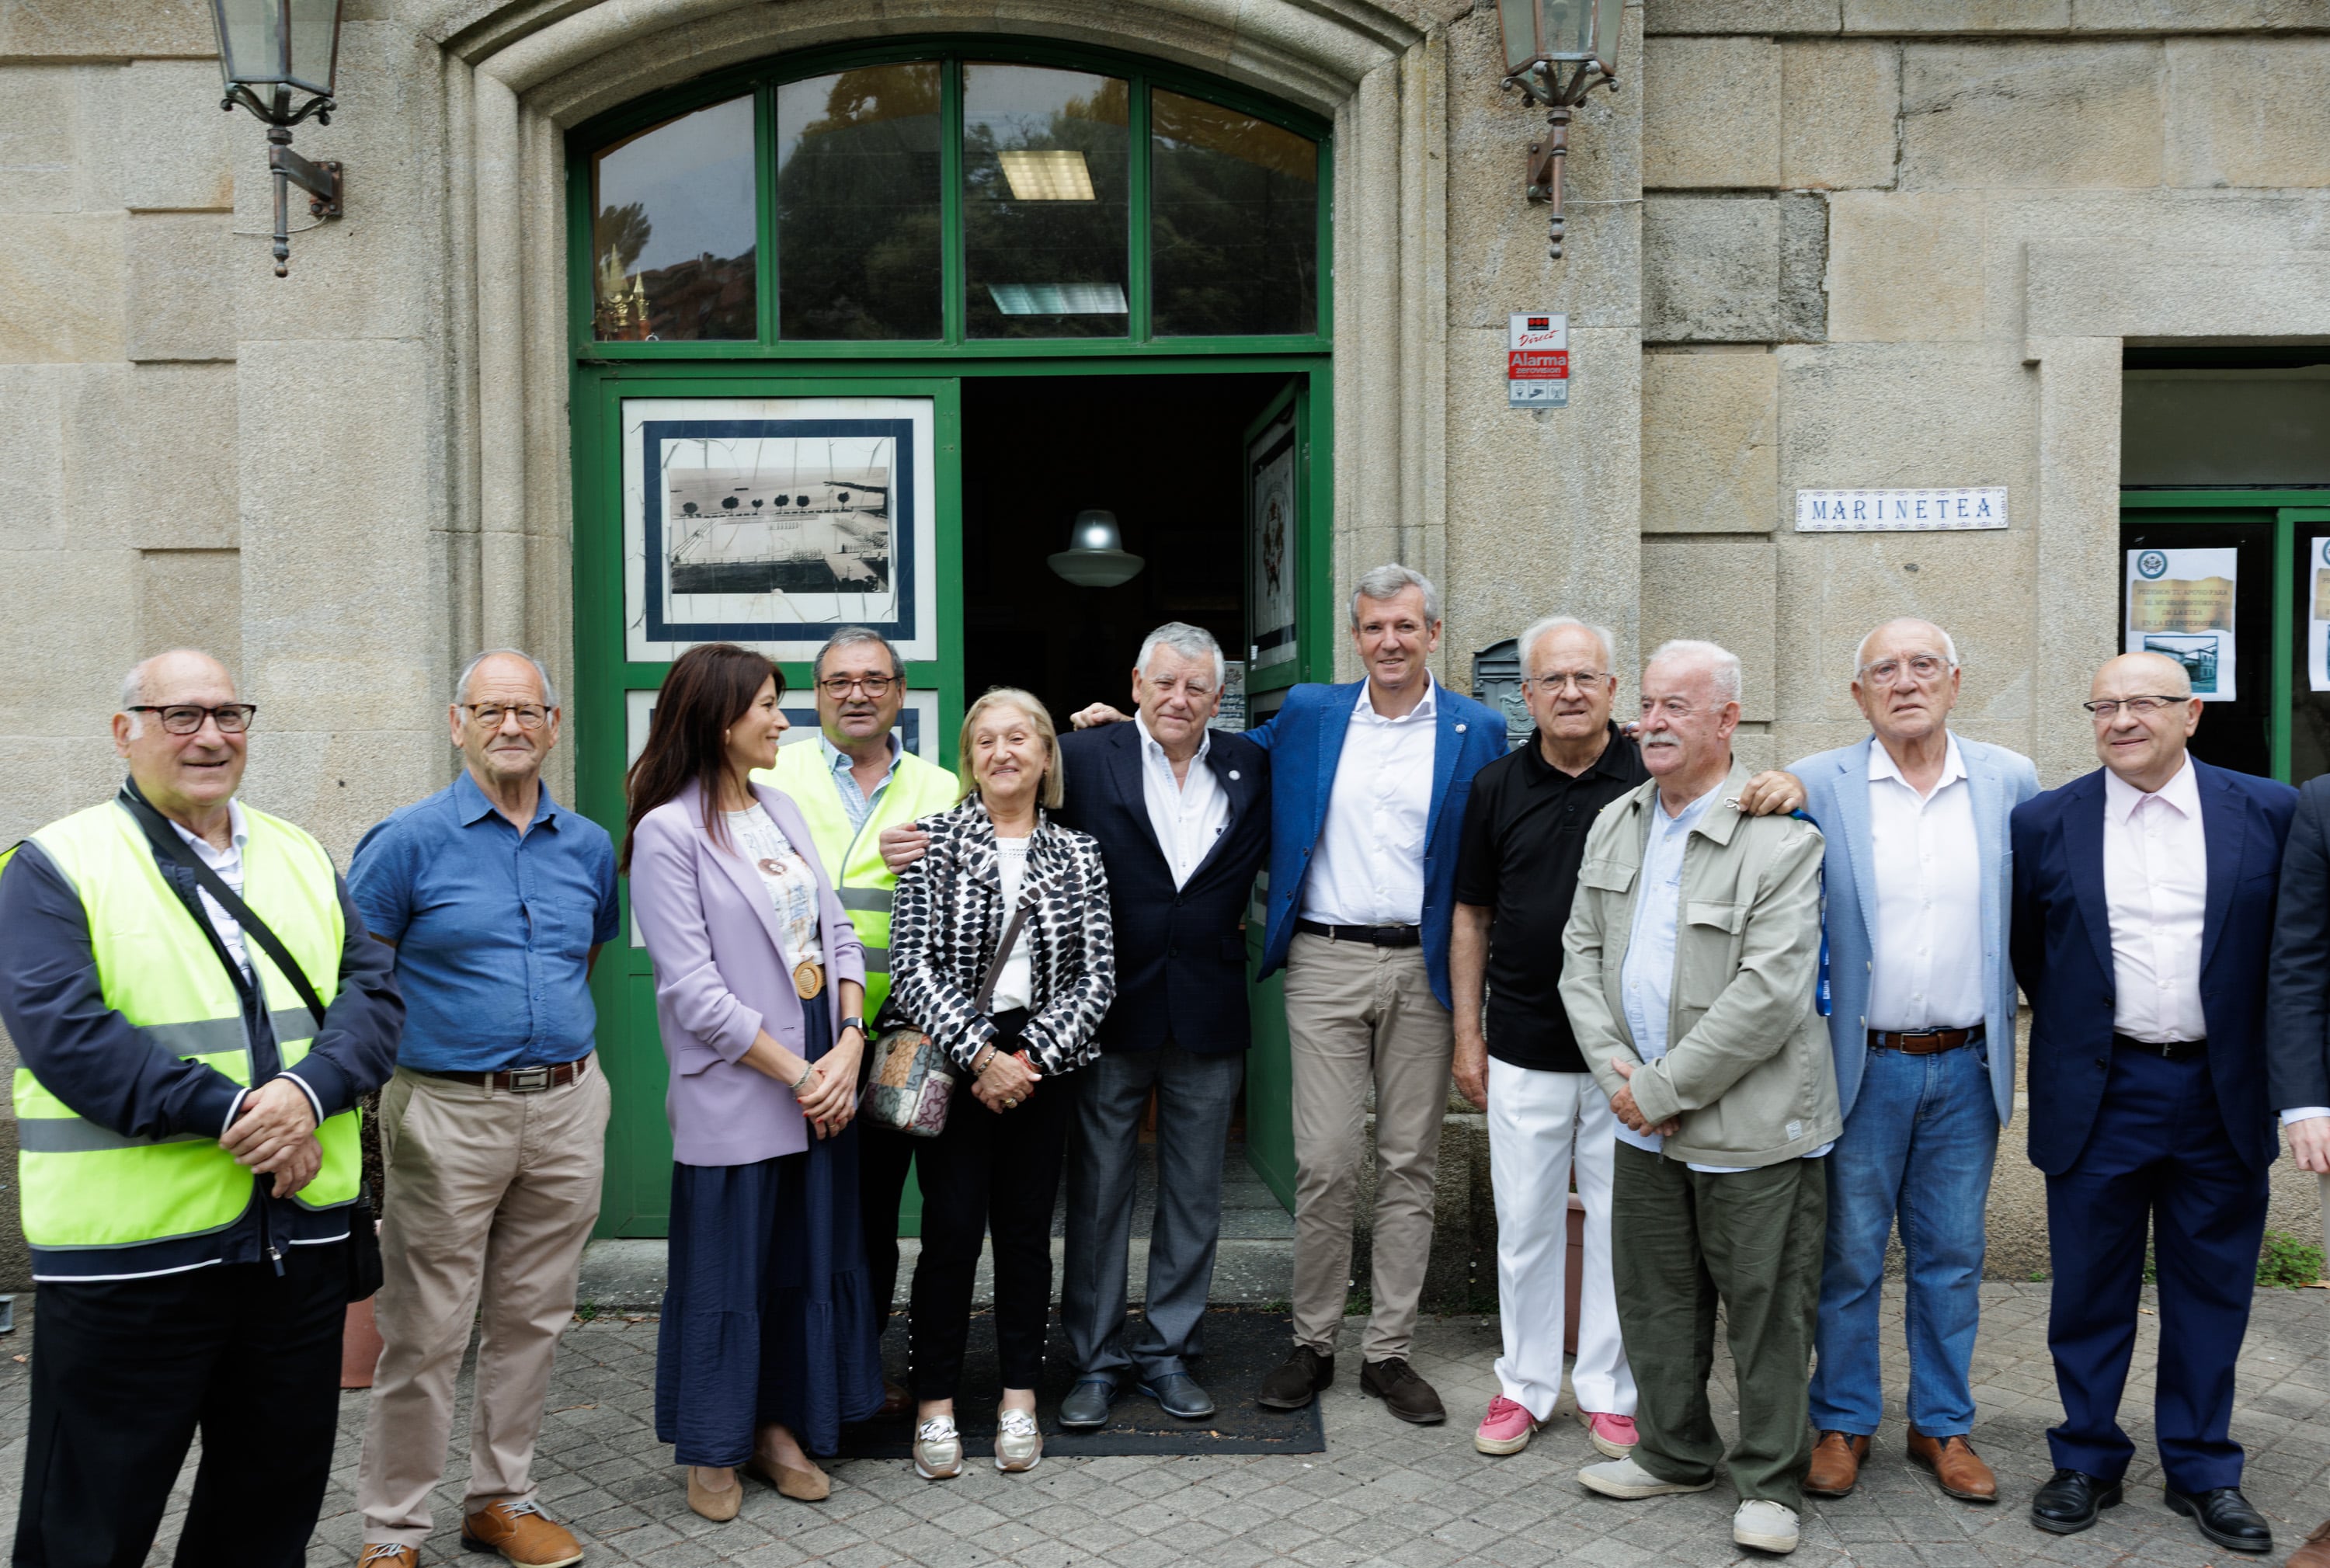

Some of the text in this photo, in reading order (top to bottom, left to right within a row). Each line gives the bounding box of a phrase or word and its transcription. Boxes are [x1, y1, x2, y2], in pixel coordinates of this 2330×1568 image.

[1518, 329, 1560, 346] Direct
[1511, 352, 1567, 366] Alarma
[1811, 497, 1992, 520] MARINETEA
